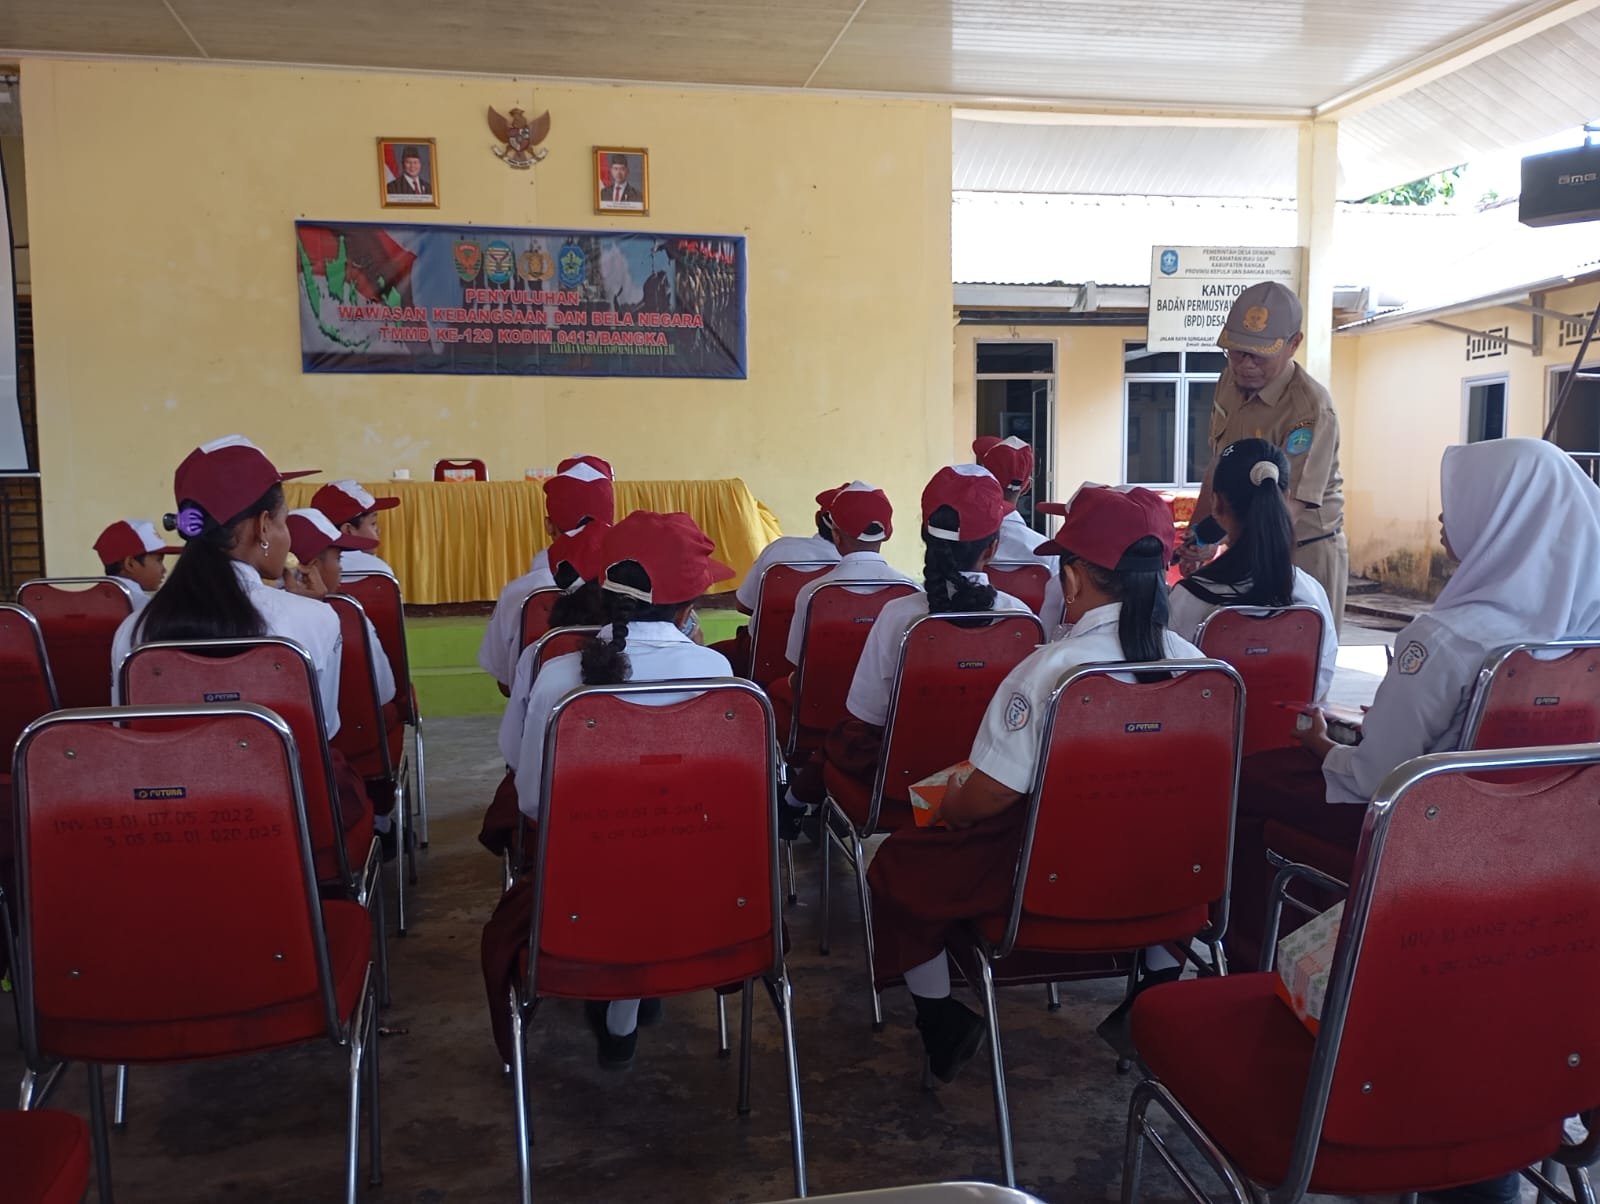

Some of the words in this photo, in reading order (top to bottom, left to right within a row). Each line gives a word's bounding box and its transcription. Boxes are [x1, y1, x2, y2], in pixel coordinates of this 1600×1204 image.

[465, 288, 580, 305] PENYULUHAN
[1157, 299, 1185, 311] BADAN
[337, 305, 427, 322] WAWASAN
[432, 307, 548, 325] KEBANGSAAN
[553, 311, 587, 325] DAN
[591, 311, 633, 326] BELA
[638, 312, 704, 328] NEGARA
[1184, 314, 1205, 328] (BPD)
[1206, 315, 1225, 326] DESA
[380, 326, 430, 342] TMMD
[436, 327, 494, 343] KE-129
[498, 328, 553, 344] KODIM
[557, 330, 668, 346] 0413/BANGKA
[149, 788, 183, 798] FUTURA
